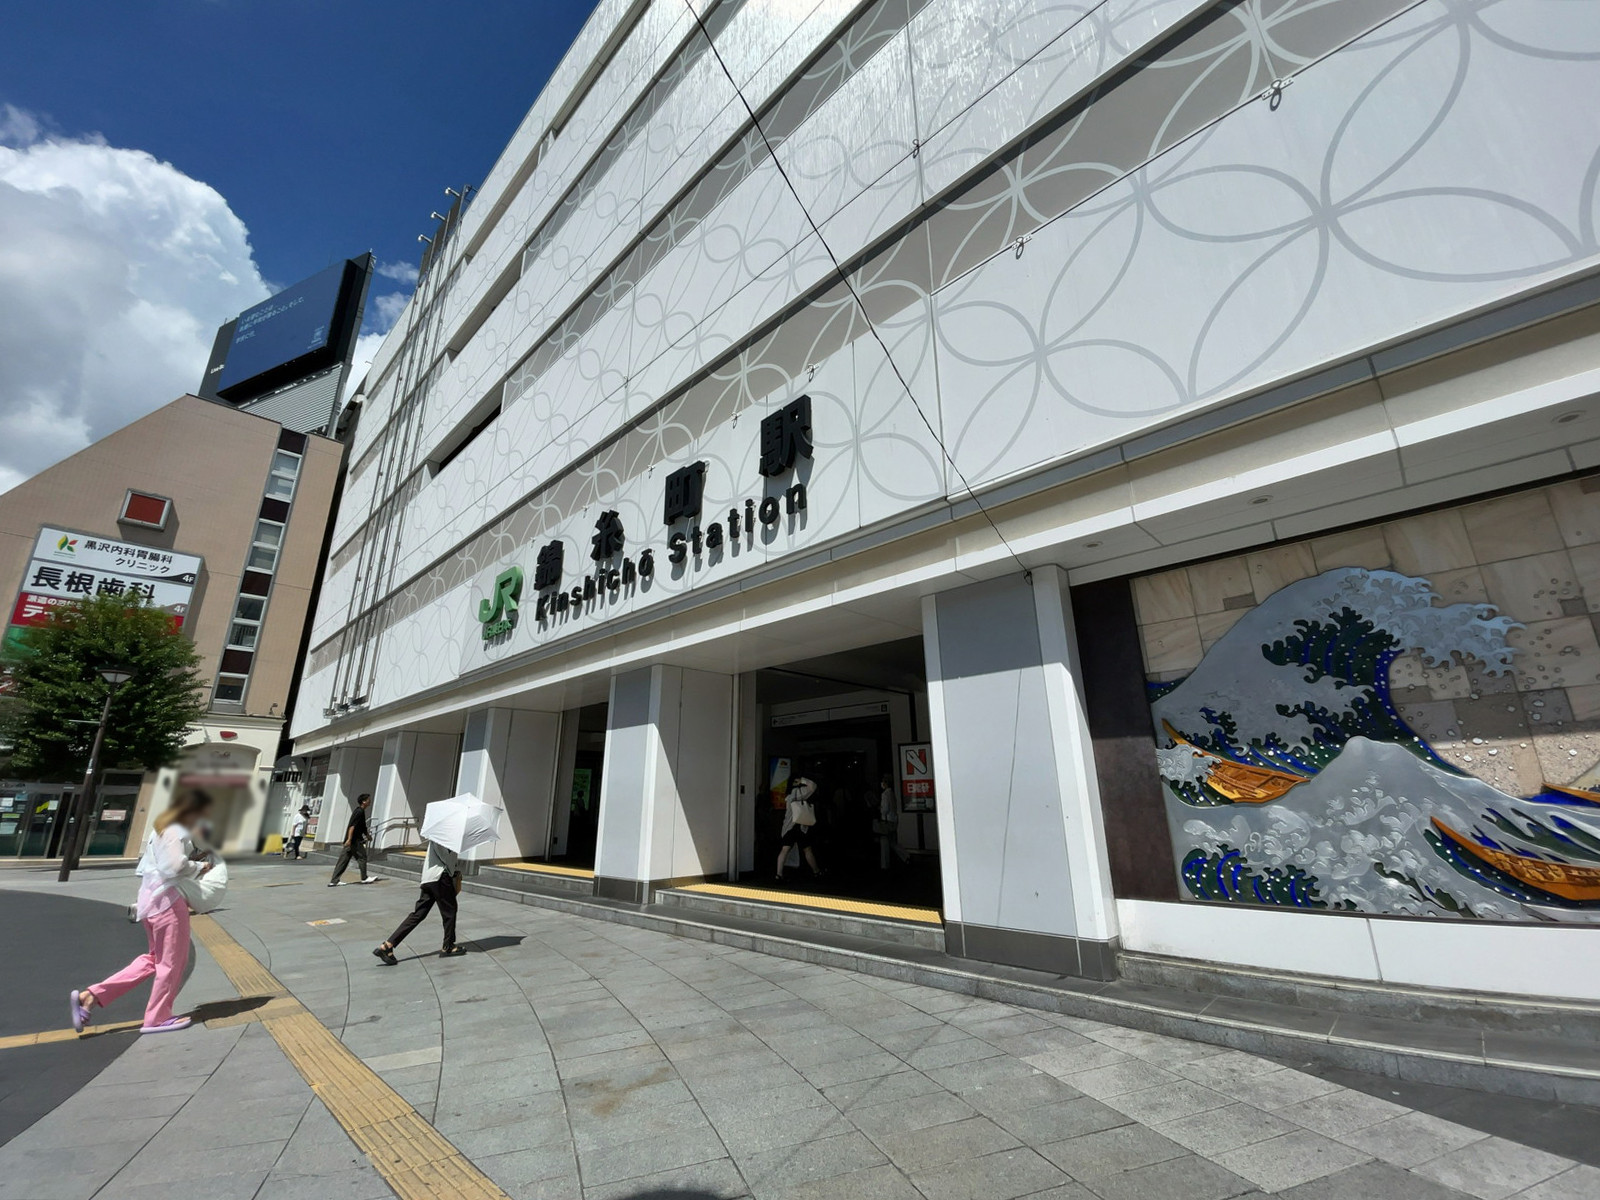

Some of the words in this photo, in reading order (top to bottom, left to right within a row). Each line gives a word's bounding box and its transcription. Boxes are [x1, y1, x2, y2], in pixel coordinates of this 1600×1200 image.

[534, 395, 813, 590] 錦糸町駅
[668, 483, 807, 563] Station
[84, 540, 173, 564] 黒沢内科胃腸科
[115, 558, 170, 574] クリニック
[31, 566, 156, 600] 長根歯科
[182, 574, 195, 583] 4F
[173, 604, 186, 613] 4F
[479, 566, 523, 623] JR
